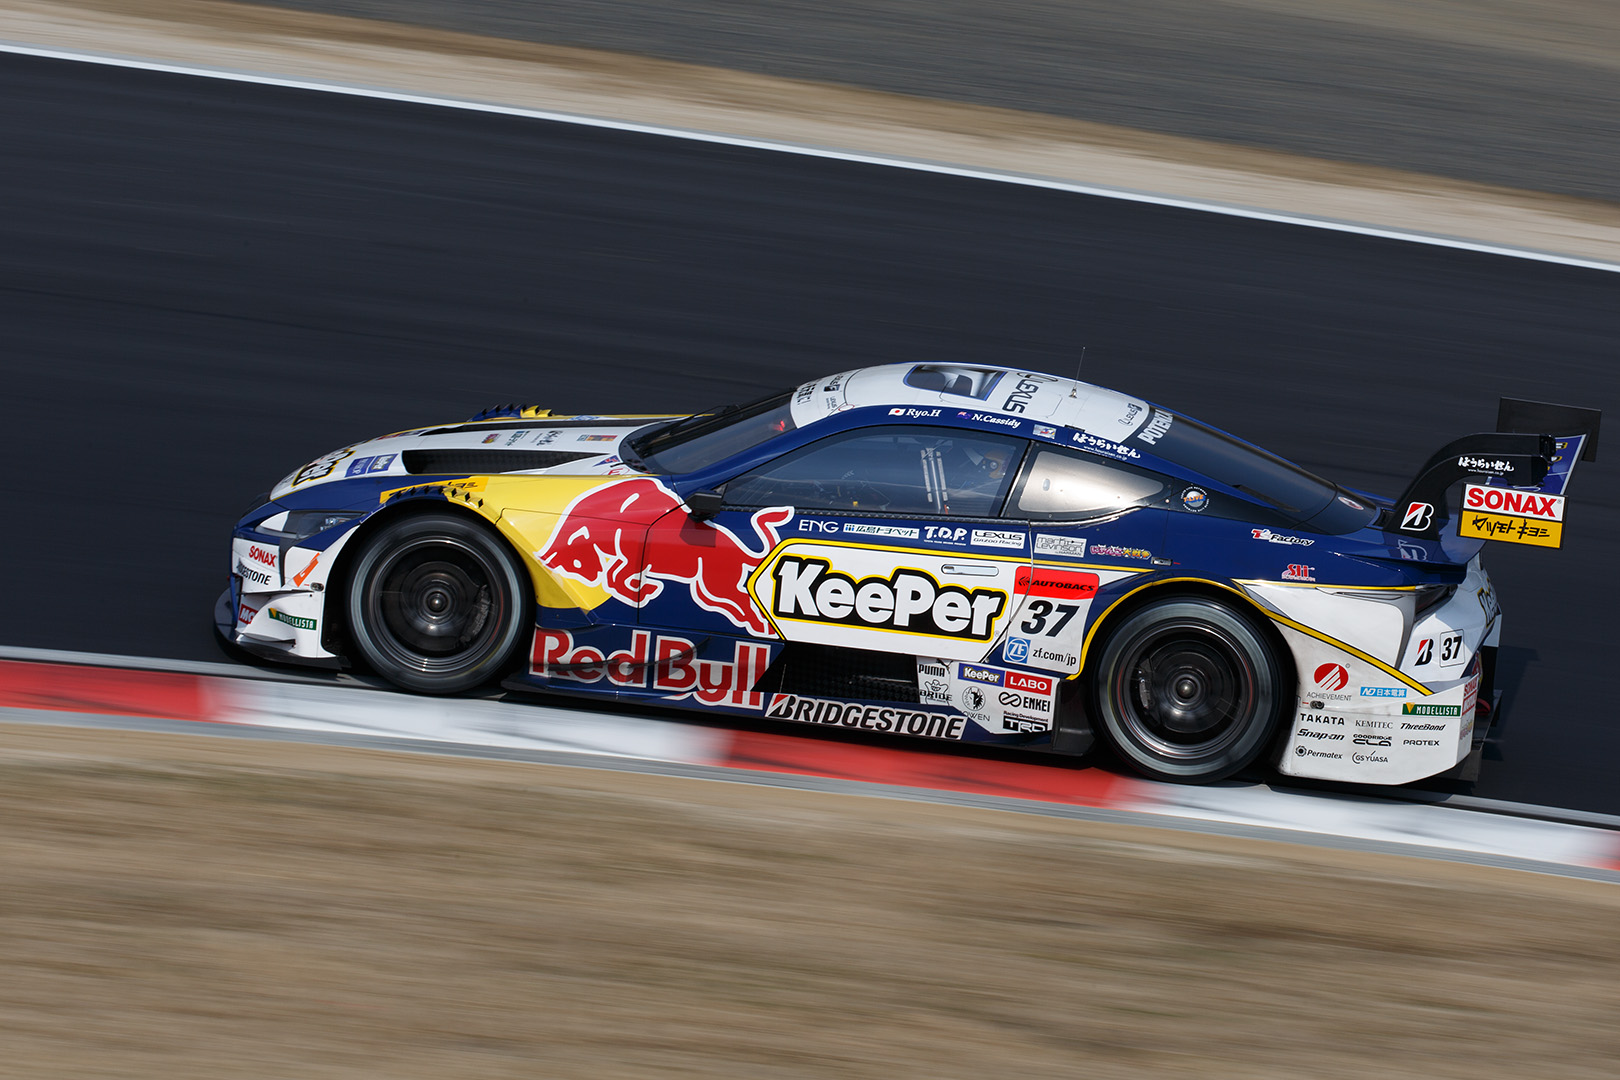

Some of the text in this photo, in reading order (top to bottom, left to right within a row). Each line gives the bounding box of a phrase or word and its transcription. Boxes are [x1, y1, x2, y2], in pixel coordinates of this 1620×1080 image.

[905, 408, 942, 419] Ryo.H
[971, 413, 1021, 429] N.Cassidy
[1467, 488, 1558, 518] SONAX
[798, 519, 839, 533] ENG
[974, 531, 1022, 541] LEXUS
[1271, 533, 1314, 546] Factory
[249, 545, 277, 568] SONAX
[1032, 579, 1095, 592] AUTOBACS
[776, 560, 1002, 636] KeePer
[1021, 600, 1080, 637] 37
[1007, 642, 1077, 667] ZF zf.com/jp
[1442, 635, 1462, 661] 37
[529, 628, 771, 710] Red Bull
[918, 663, 946, 677] PUMA
[963, 666, 1000, 683] KeePer
[1009, 676, 1048, 691] LABO
[1306, 691, 1351, 702] ACHIEVEMENT
[1023, 696, 1050, 713] ENKEI
[1416, 705, 1458, 716] MODELLISTA
[768, 693, 963, 739] BRIDGESTONE
[1300, 713, 1345, 726] TAKATA
[1004, 717, 1046, 733] TRD
[1355, 719, 1394, 730] KEMITEC
[1400, 722, 1446, 732] ThreeBond
[1297, 728, 1345, 742] Snap-on
[1403, 739, 1440, 747] PROTEX
[1307, 749, 1343, 760] Permatex
